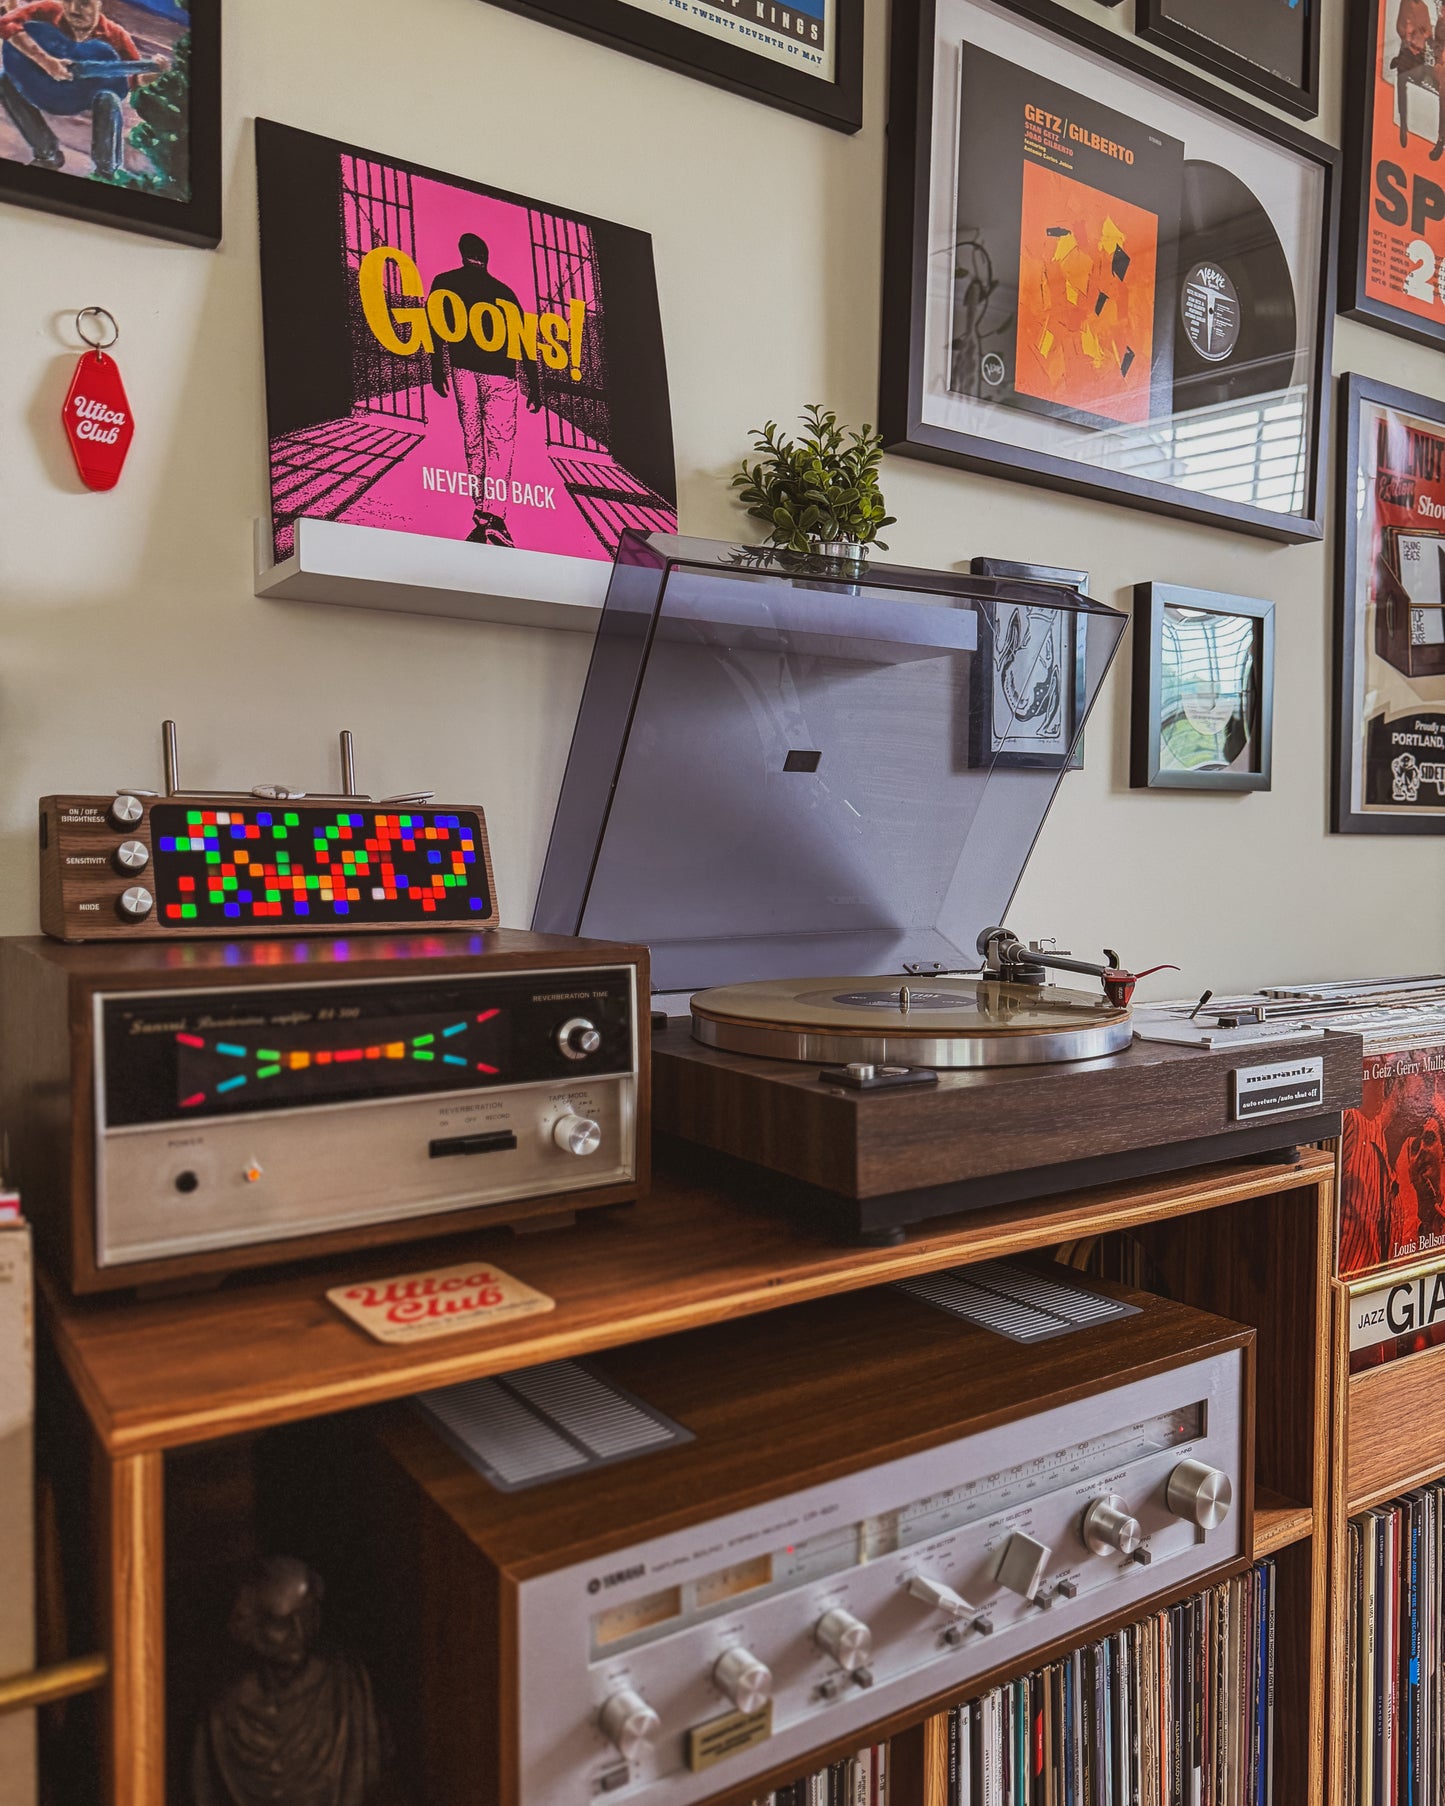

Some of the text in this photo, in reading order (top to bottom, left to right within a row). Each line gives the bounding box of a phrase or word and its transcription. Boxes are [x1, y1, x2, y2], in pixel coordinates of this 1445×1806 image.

[756, 2, 819, 41] KINGS
[668, 0, 823, 65] THE TWENTY SEVENTH OF MAY
[1024, 121, 1059, 142] STAN GETZ
[1043, 137, 1073, 157] GILBERTO
[74, 396, 126, 426] Utica
[76, 420, 120, 445] Club
[422, 466, 556, 510] NEVER GO BACK
[1411, 609, 1424, 623] TOP
[1391, 732, 1445, 750] PORTLAND,
[61, 815, 105, 823] BRIGHTNESS
[65, 857, 107, 865] SENSITIVITY
[79, 903, 100, 911] MODE
[532, 991, 609, 1003] REVERBERATION TIME
[1246, 1066, 1314, 1084] marantz
[1372, 1063, 1392, 1080] Getz
[1396, 1059, 1421, 1077] Gerry
[548, 1091, 588, 1103] TAPE MODE
[1242, 1101, 1257, 1109] auto
[1294, 1091, 1307, 1099] shut
[1307, 1088, 1318, 1097] off
[439, 1102, 503, 1115] REVERBERATION
[485, 1112, 512, 1121] RECORD
[1393, 1238, 1416, 1258] Louis
[344, 1270, 498, 1308] Utica
[386, 1285, 503, 1324] Club
[1358, 1308, 1385, 1329] JAZZ
[1075, 1471, 1127, 1495] VOLUME BALANCE
[988, 1518, 1004, 1528] INPUT
[1005, 1507, 1033, 1521] SELECTOR
